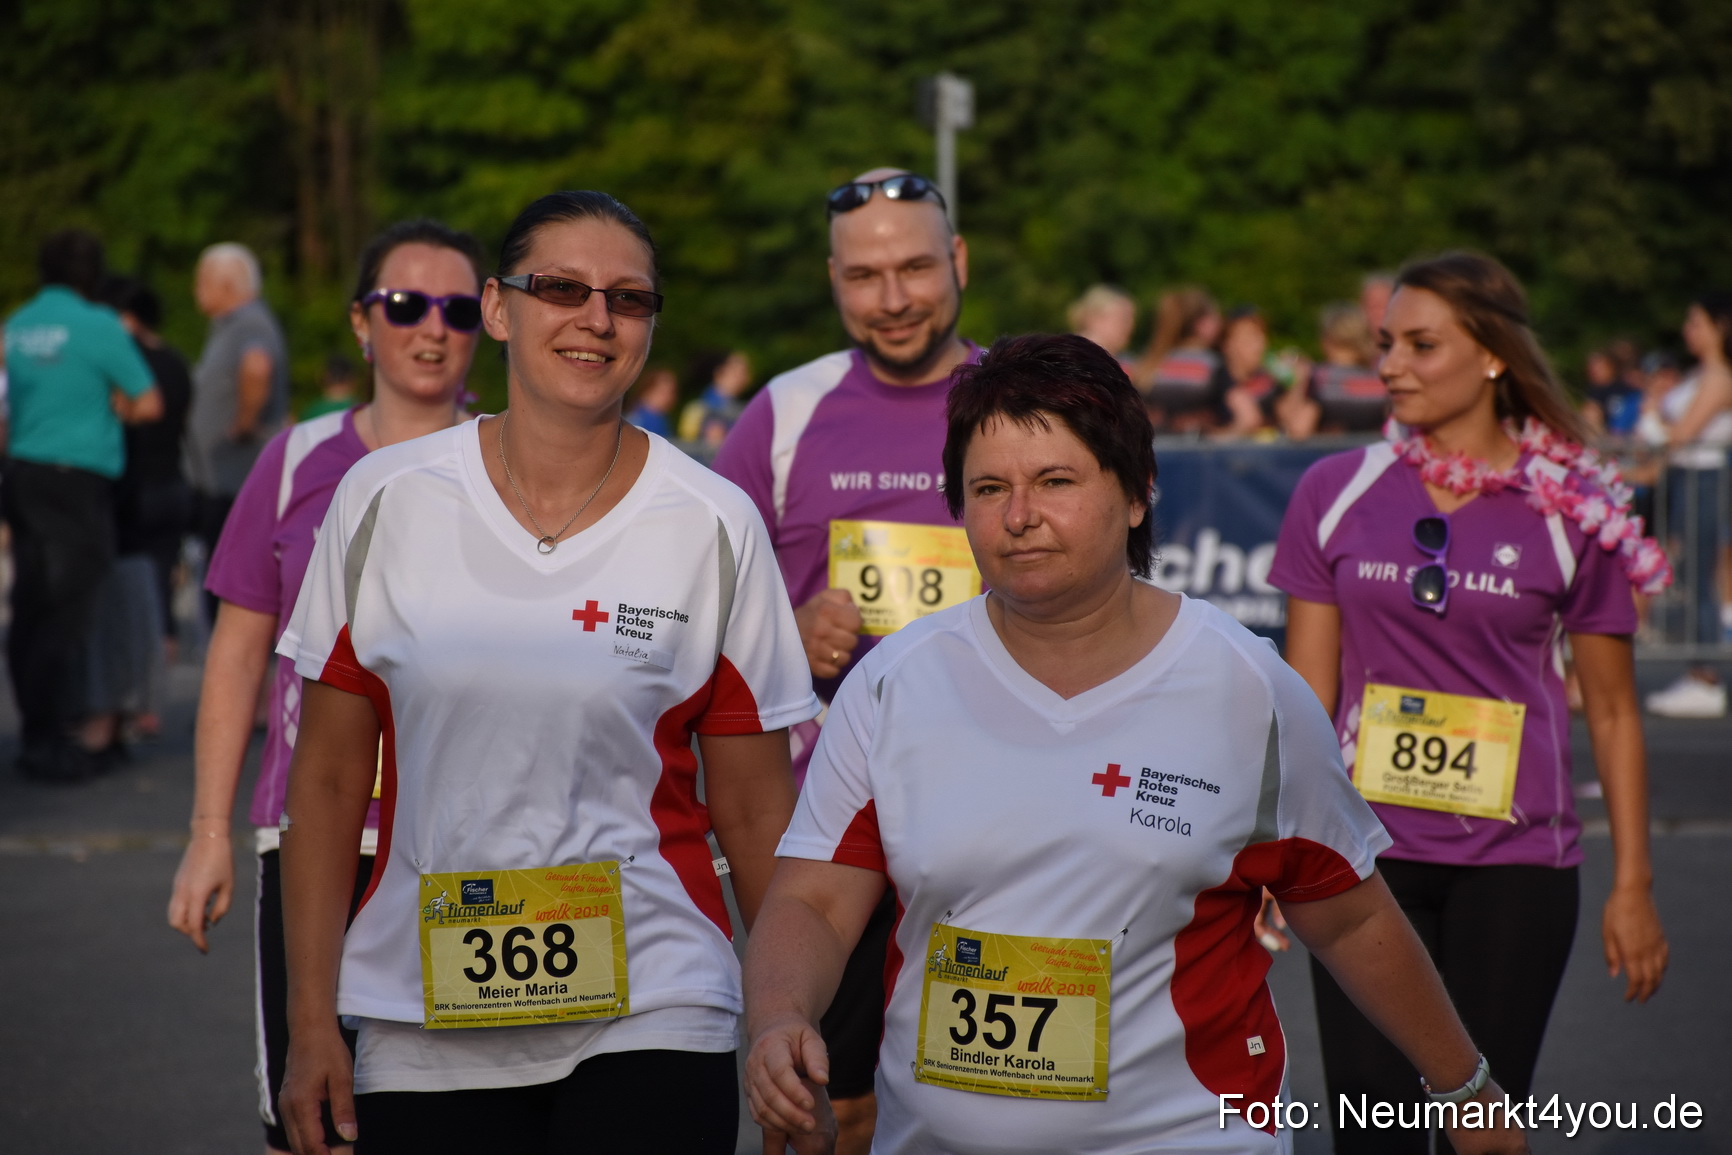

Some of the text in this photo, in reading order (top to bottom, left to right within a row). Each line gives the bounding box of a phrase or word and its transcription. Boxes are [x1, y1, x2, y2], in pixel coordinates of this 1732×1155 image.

[830, 472, 872, 490] WIR
[878, 472, 931, 491] SIND
[859, 564, 943, 606] 908
[1358, 561, 1399, 583] WIR
[1465, 571, 1520, 599] LILA.
[616, 614, 654, 629] Rotes
[618, 603, 689, 623] Bayerisches
[616, 625, 653, 641] Kreuz
[613, 644, 648, 659] Natalia
[1391, 732, 1477, 780] 894
[1138, 779, 1178, 795] Rotes
[1141, 767, 1221, 794] Bayerisches
[1136, 790, 1176, 807] Kreuz
[1130, 808, 1191, 837] Karola
[545, 872, 579, 881] Gesunde
[561, 883, 584, 893] laufen
[448, 899, 525, 917] firmenlauf
[535, 903, 609, 921] walk 2019
[462, 923, 578, 983] 368
[1030, 942, 1067, 956] Gesunde
[945, 958, 1009, 981] firmenlauf
[1046, 956, 1071, 968] laufen
[478, 982, 568, 999] Meier Maria
[1017, 977, 1096, 996] walk 2019
[434, 1003, 450, 1011] BRK
[451, 1001, 512, 1010] Seniorenzentren
[513, 997, 560, 1007] Woffenbach
[579, 992, 616, 1001] Neumarkt
[949, 988, 1058, 1052] 357
[951, 1047, 1055, 1071] Bindler Karola
[923, 1058, 935, 1067] BRK
[936, 1061, 988, 1075] Seniorenzentren
[989, 1068, 1035, 1080] Woffenbach
[1055, 1074, 1094, 1083] Neumarkt
